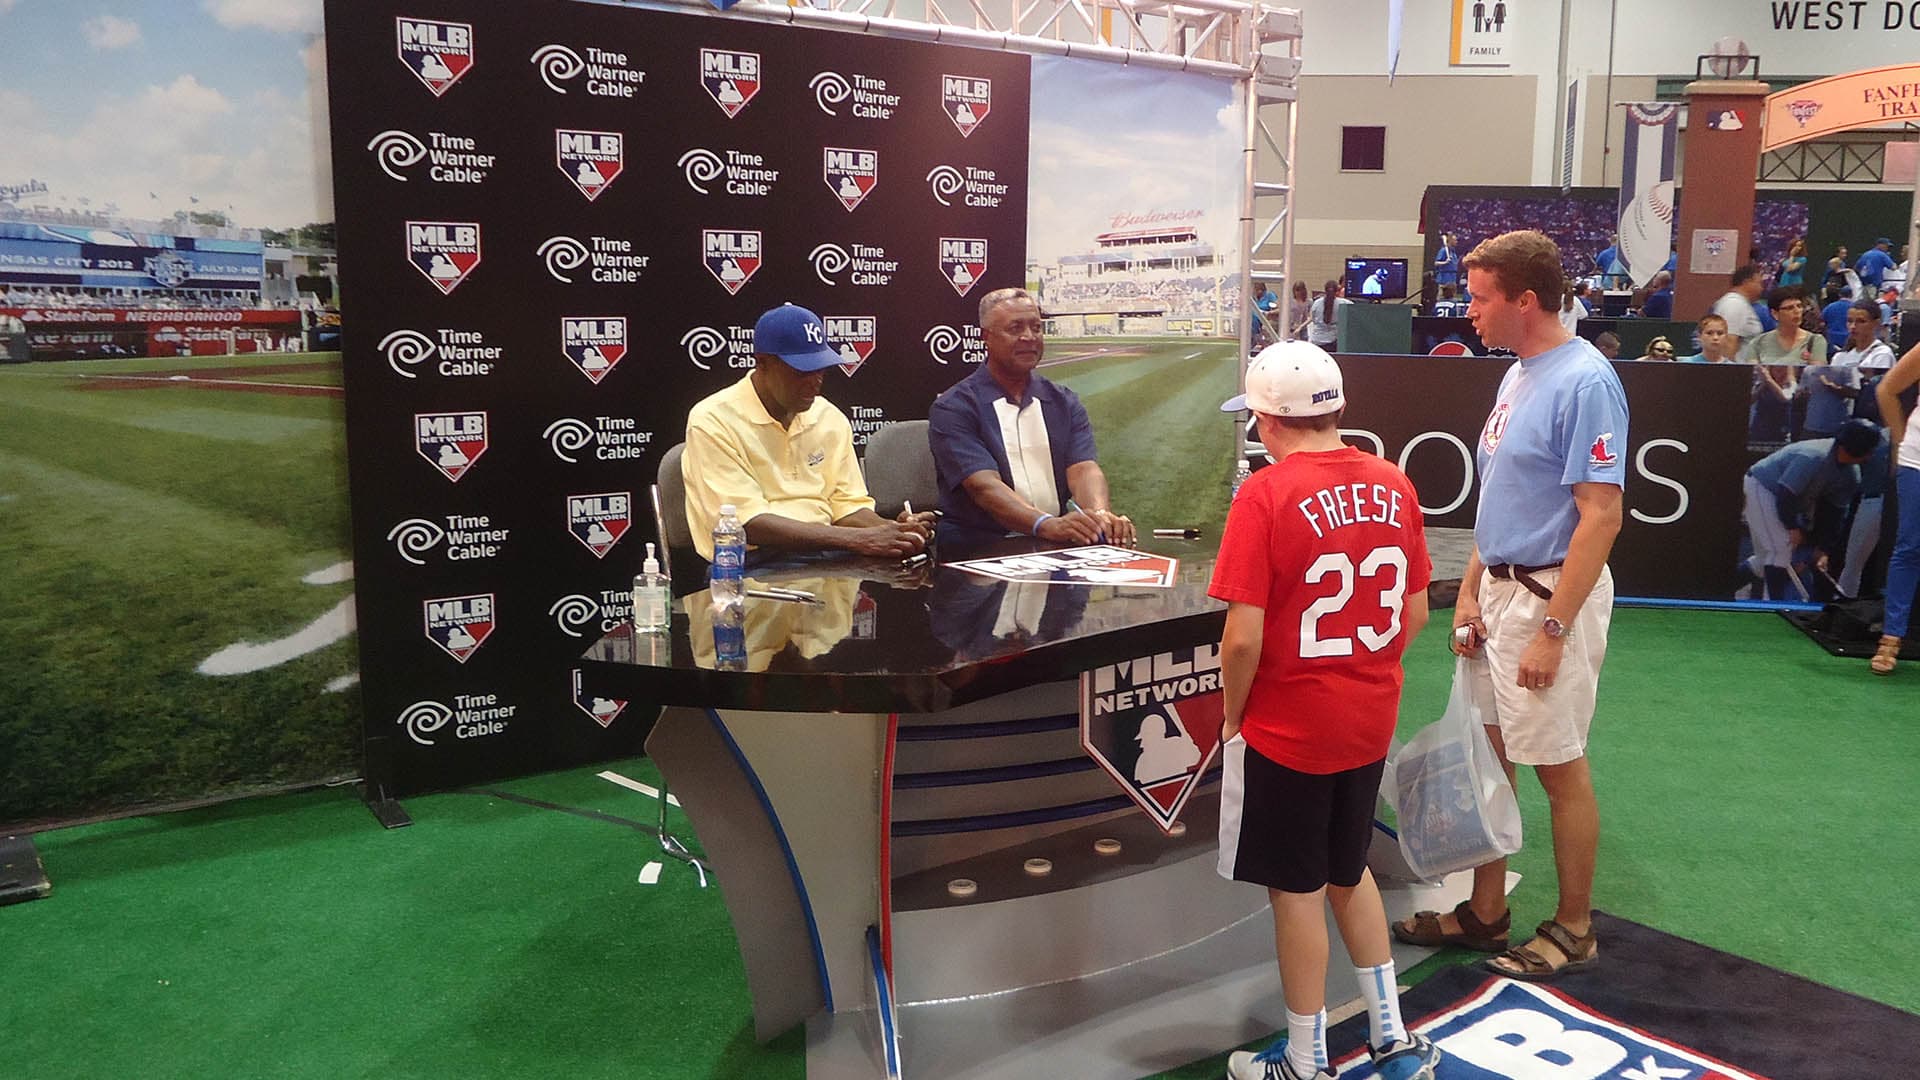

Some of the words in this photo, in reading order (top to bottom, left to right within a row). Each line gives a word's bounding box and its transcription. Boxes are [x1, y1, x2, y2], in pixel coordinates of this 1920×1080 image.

[1771, 0, 1867, 30] WEST
[402, 22, 469, 47] MLB
[403, 43, 469, 56] NETWORK
[586, 47, 627, 66] Time
[1470, 47, 1502, 56] FAMILY
[704, 52, 758, 74] MLB
[586, 64, 646, 83] Warner
[705, 71, 758, 81] NETWORK
[587, 79, 634, 98] Cable
[853, 74, 886, 90] Time
[945, 78, 988, 99] MLB
[853, 89, 900, 106] Warner
[945, 95, 988, 105] NETWORK
[853, 103, 890, 119] Cable
[429, 132, 475, 150] Time
[561, 133, 619, 155] MLB
[429, 149, 495, 167] Warner
[561, 153, 619, 163] NETWORK
[727, 150, 763, 166] Time
[828, 150, 874, 170] MLB
[430, 166, 482, 184] Cable
[727, 164, 779, 182] Warner
[828, 168, 874, 176] NETWORK
[966, 166, 996, 181] Time
[727, 180, 767, 195] Cable
[966, 180, 1008, 195] Warner
[965, 193, 999, 207] Cable
[411, 226, 476, 246] MLB
[707, 233, 758, 252] MLB
[412, 245, 476, 254] NETWORK
[591, 237, 631, 252] Time
[851, 244, 884, 258] Time
[943, 241, 985, 258] MLB
[591, 252, 649, 267] Warner
[707, 250, 758, 258] NETWORK
[942, 256, 985, 264] NETWORK
[54, 258, 92, 267] CITY
[98, 259, 134, 269] 2012
[852, 258, 899, 273] Warner
[592, 268, 636, 283] Cable
[852, 272, 888, 285] Cable
[126, 311, 242, 321] NEIGHBORHOOD
[566, 320, 624, 339] MLB
[728, 326, 755, 339] Tim
[803, 323, 823, 344] KC
[827, 320, 873, 337] MLB
[438, 329, 482, 344] Time
[962, 338, 985, 350] War
[438, 345, 502, 360] Warner
[439, 361, 489, 376] Cable
[728, 354, 756, 368] Cab
[850, 406, 883, 418] Time
[420, 415, 484, 437] MLB
[596, 416, 635, 430] Time
[421, 434, 484, 444] NETWORK
[596, 431, 653, 445] Warner
[596, 446, 641, 461] Cable
[572, 496, 628, 518] MLB
[1299, 483, 1403, 539] FREESE
[446, 515, 489, 530] Time
[572, 513, 628, 523] NETWORK
[446, 529, 509, 546] Warner
[447, 544, 496, 561] Cable
[429, 598, 491, 622] MLB
[1299, 546, 1408, 659] 23
[600, 605, 634, 618] War
[430, 615, 491, 629] NETWORK
[454, 694, 496, 710] Time
[455, 705, 516, 725] Warner
[455, 721, 504, 739] Cable
